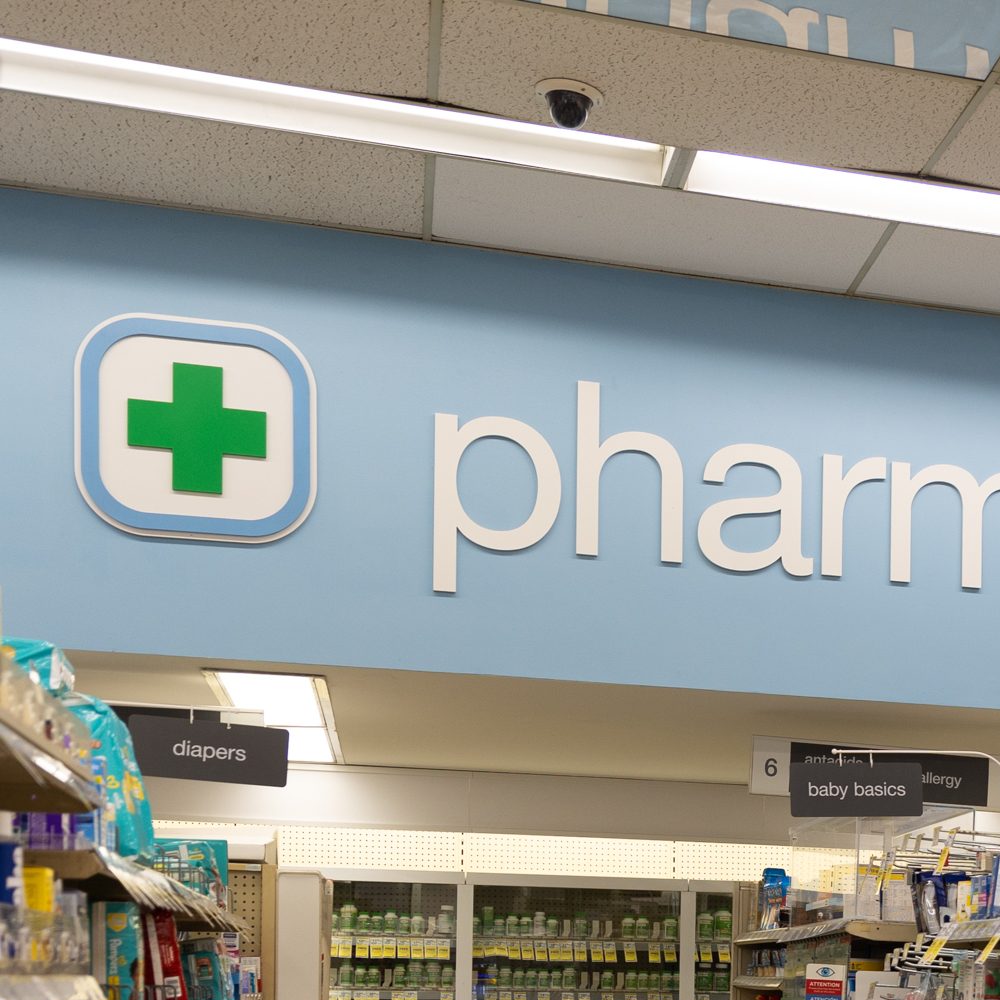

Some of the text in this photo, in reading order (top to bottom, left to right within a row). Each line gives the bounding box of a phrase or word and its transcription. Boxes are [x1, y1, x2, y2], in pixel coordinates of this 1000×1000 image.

[172, 740, 247, 762] diapers
[764, 758, 778, 777] 6
[921, 771, 962, 789] allergy
[808, 781, 906, 800] baby basics
